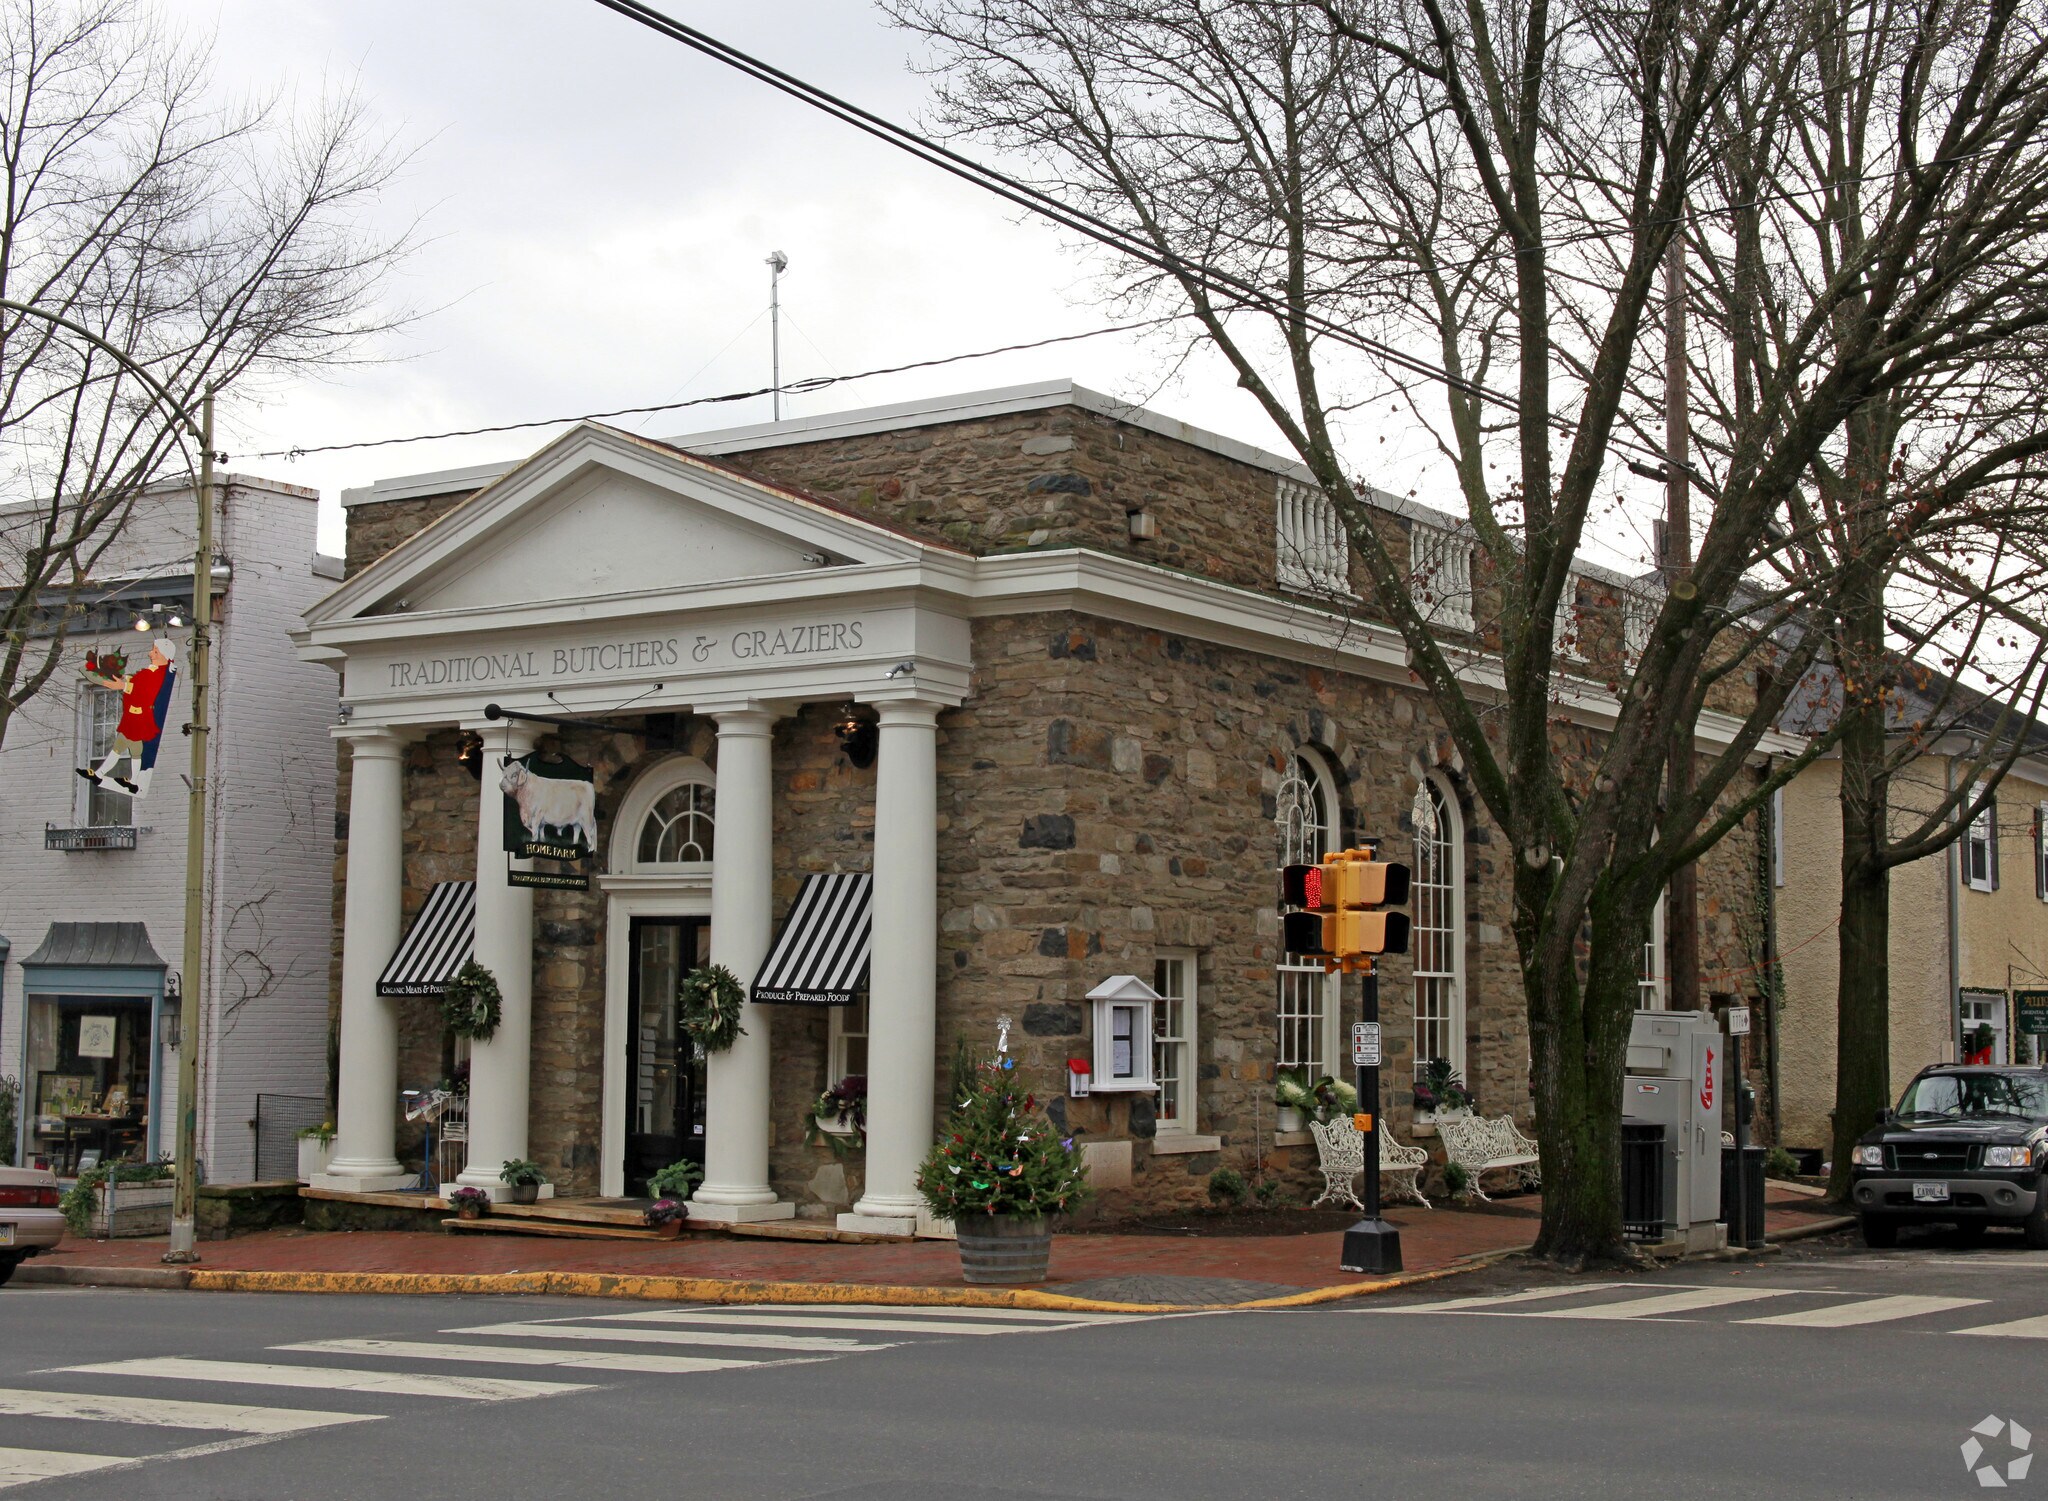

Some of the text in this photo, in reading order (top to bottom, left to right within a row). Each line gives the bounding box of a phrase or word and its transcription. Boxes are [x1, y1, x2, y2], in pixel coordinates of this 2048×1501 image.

[388, 620, 864, 688] TRADITIONAL BUTCHERS & GRAZIERS
[526, 843, 576, 859] HOME FARM
[755, 989, 850, 1002] PRODUCE & PREPARED FOODS
